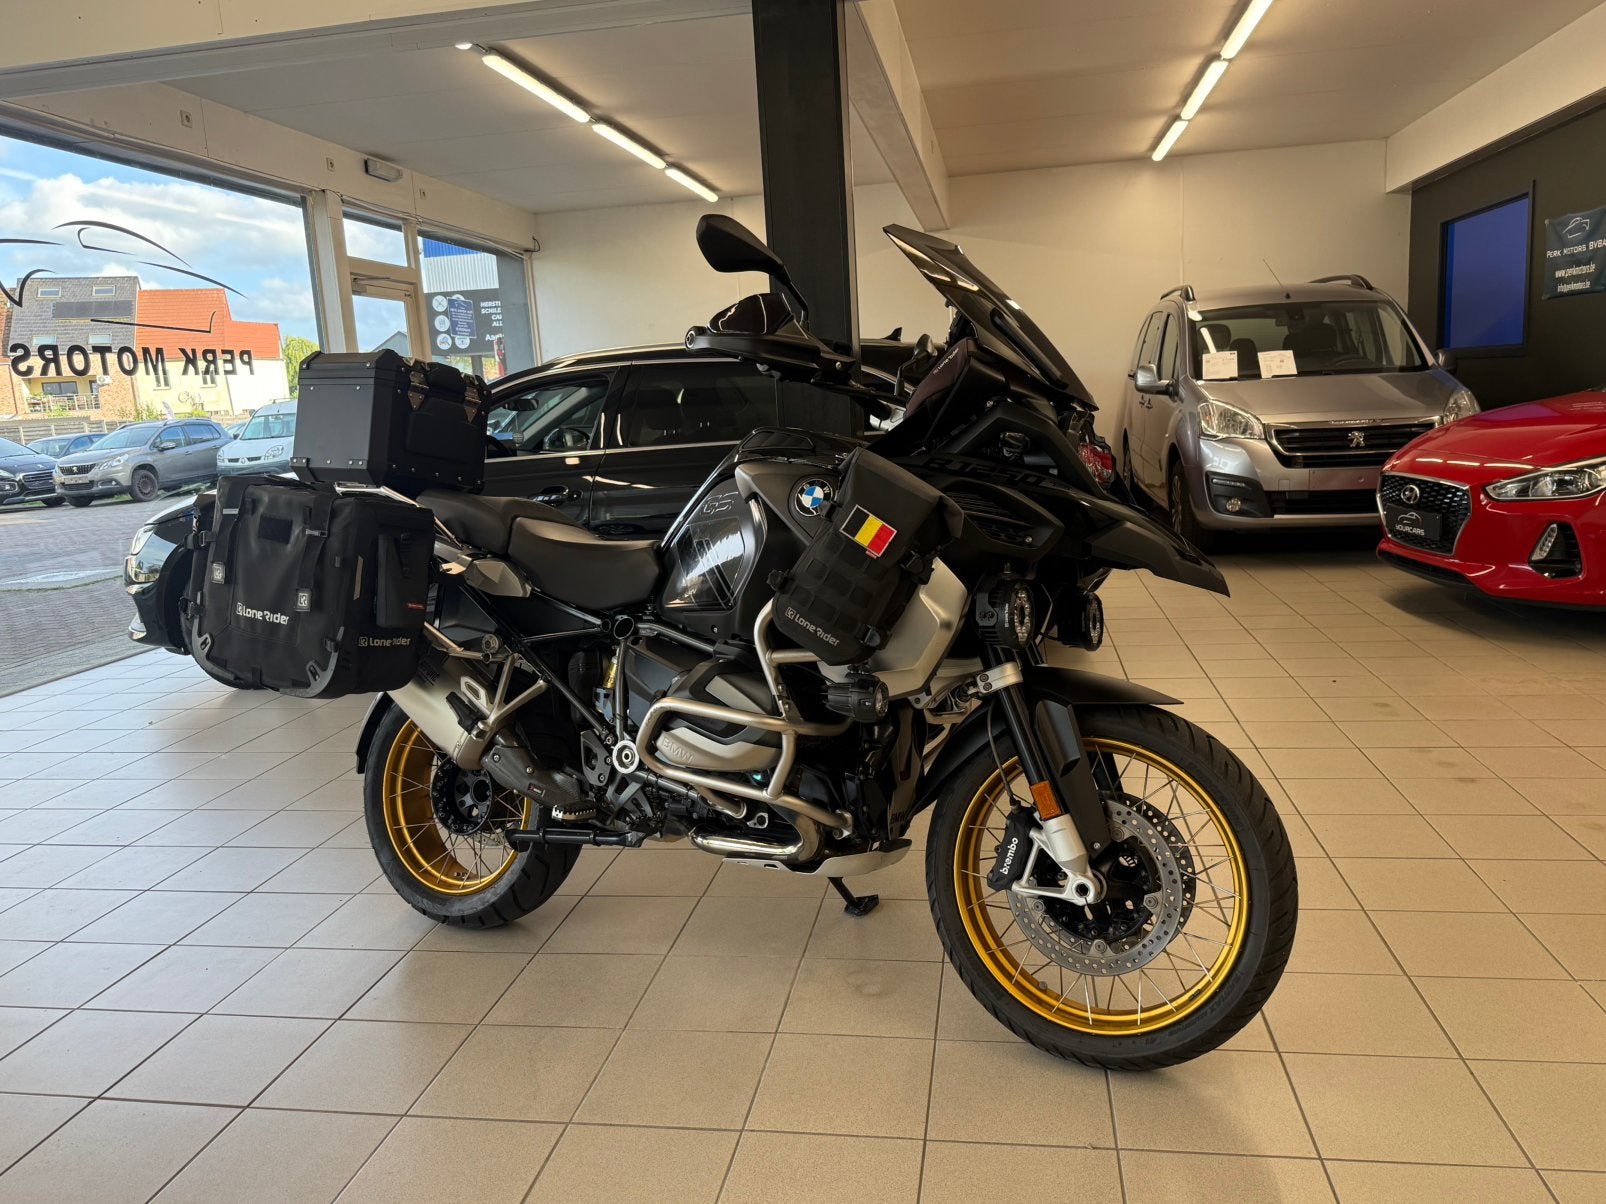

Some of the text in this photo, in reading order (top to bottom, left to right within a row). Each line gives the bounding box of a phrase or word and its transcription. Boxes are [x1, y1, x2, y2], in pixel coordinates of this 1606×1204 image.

[1546, 249, 1562, 258] PERK
[816, 627, 840, 647] Rider
[661, 736, 695, 763] BMW
[999, 836, 1019, 875] brembo
